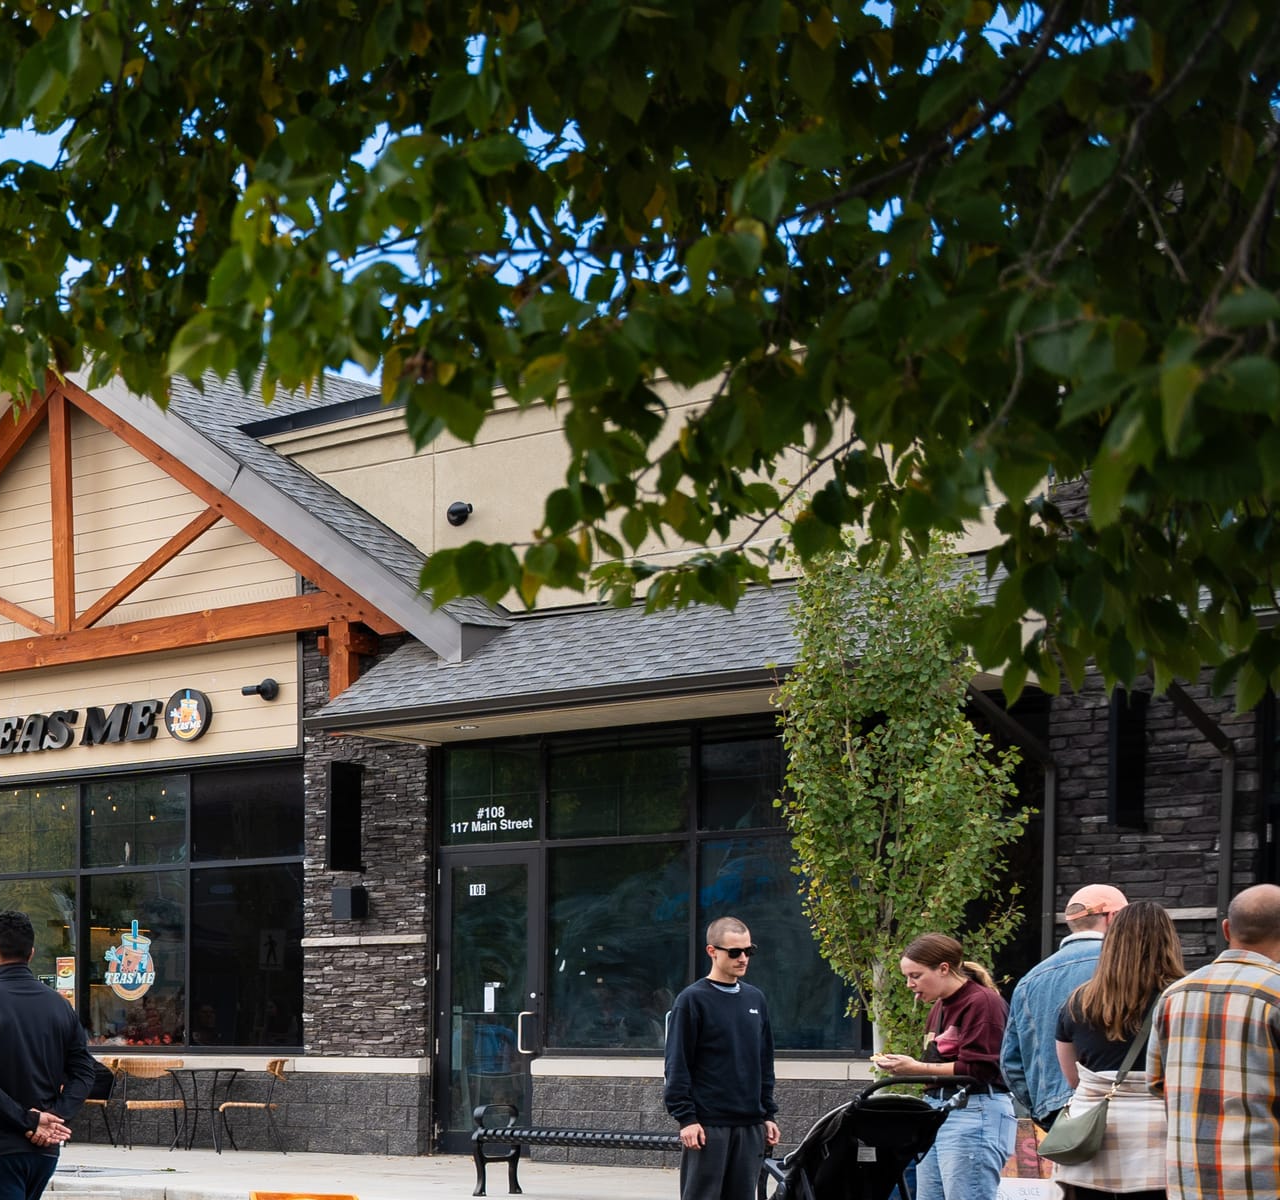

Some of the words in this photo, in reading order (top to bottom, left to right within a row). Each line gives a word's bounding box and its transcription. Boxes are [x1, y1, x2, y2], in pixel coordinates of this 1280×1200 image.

[79, 699, 164, 746] ME
[477, 806, 505, 819] #108
[450, 822, 469, 833] 117
[471, 820, 497, 832] Main
[500, 817, 533, 830] Street
[471, 885, 485, 895] 108
[105, 971, 136, 985] TEAS
[136, 972, 155, 985] ME
